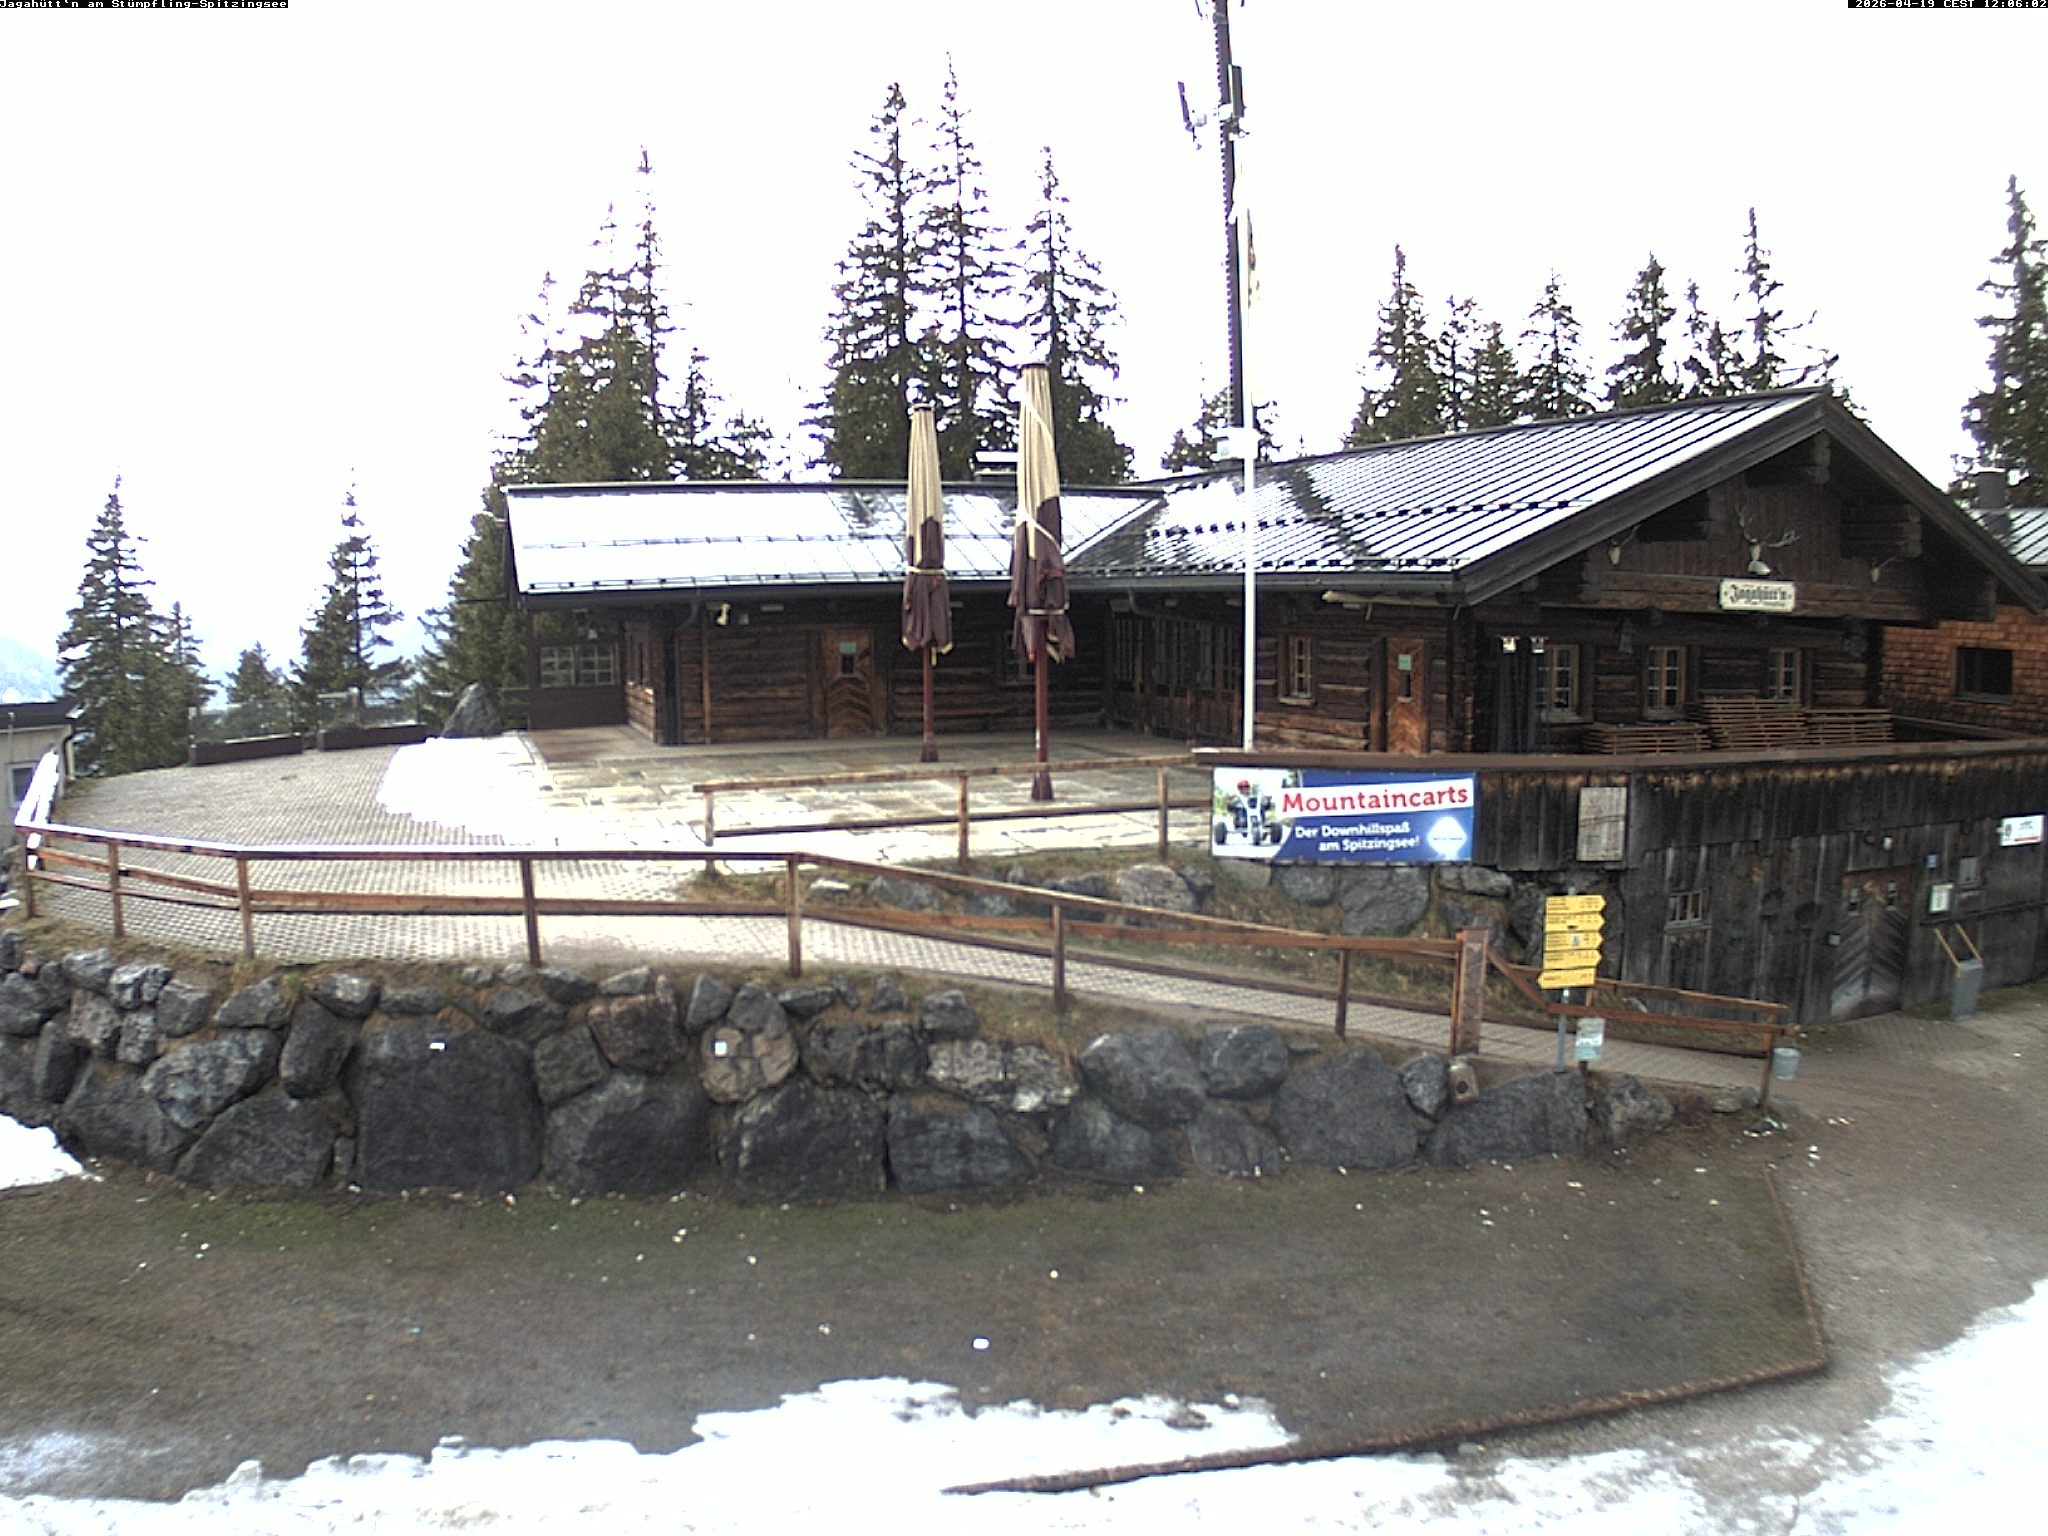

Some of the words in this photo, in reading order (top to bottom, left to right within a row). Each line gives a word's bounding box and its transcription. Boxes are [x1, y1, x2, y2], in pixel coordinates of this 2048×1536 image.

[1282, 785, 1470, 813] Mountaincarts
[1295, 826, 1318, 838] Der
[1321, 821, 1411, 837] Downhillspaß
[1319, 841, 1340, 852] am
